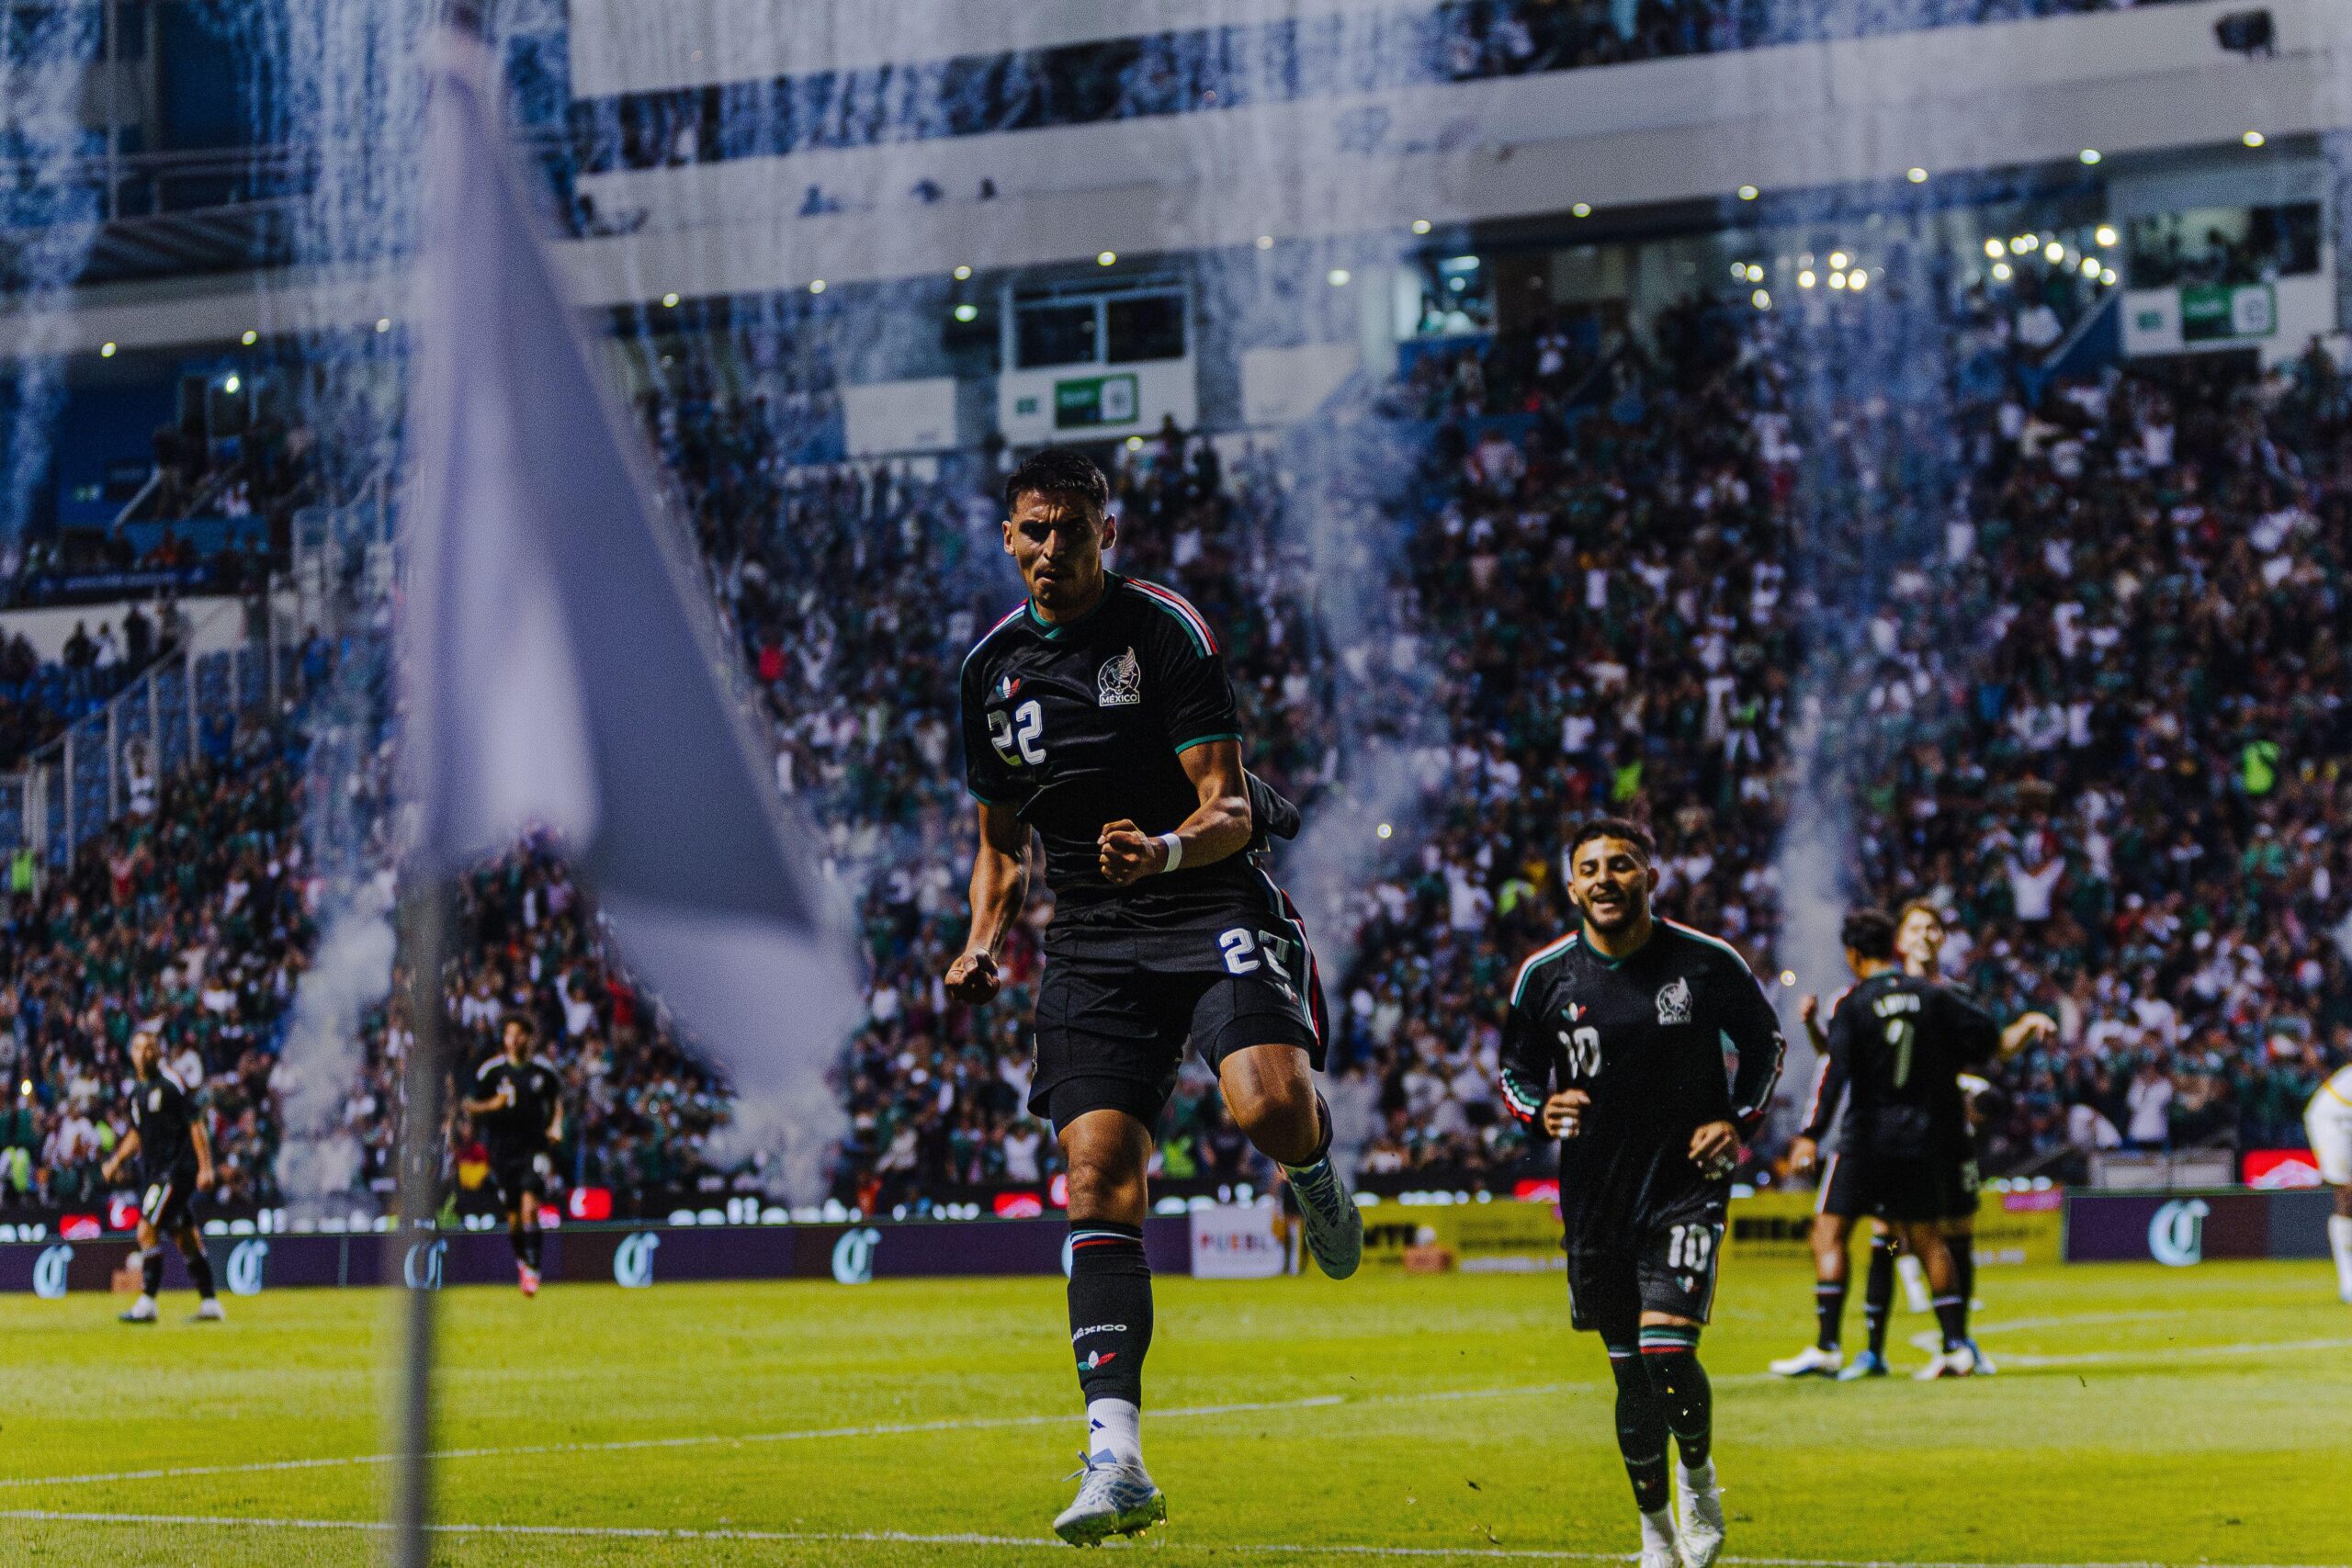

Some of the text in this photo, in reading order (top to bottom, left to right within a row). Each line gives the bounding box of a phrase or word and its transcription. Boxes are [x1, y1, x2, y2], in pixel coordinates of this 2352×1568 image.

[1101, 694, 1137, 704] MÉXICO
[988, 700, 1046, 766] 22
[1558, 1026, 1601, 1079] 10
[1668, 1224, 1712, 1271] 10
